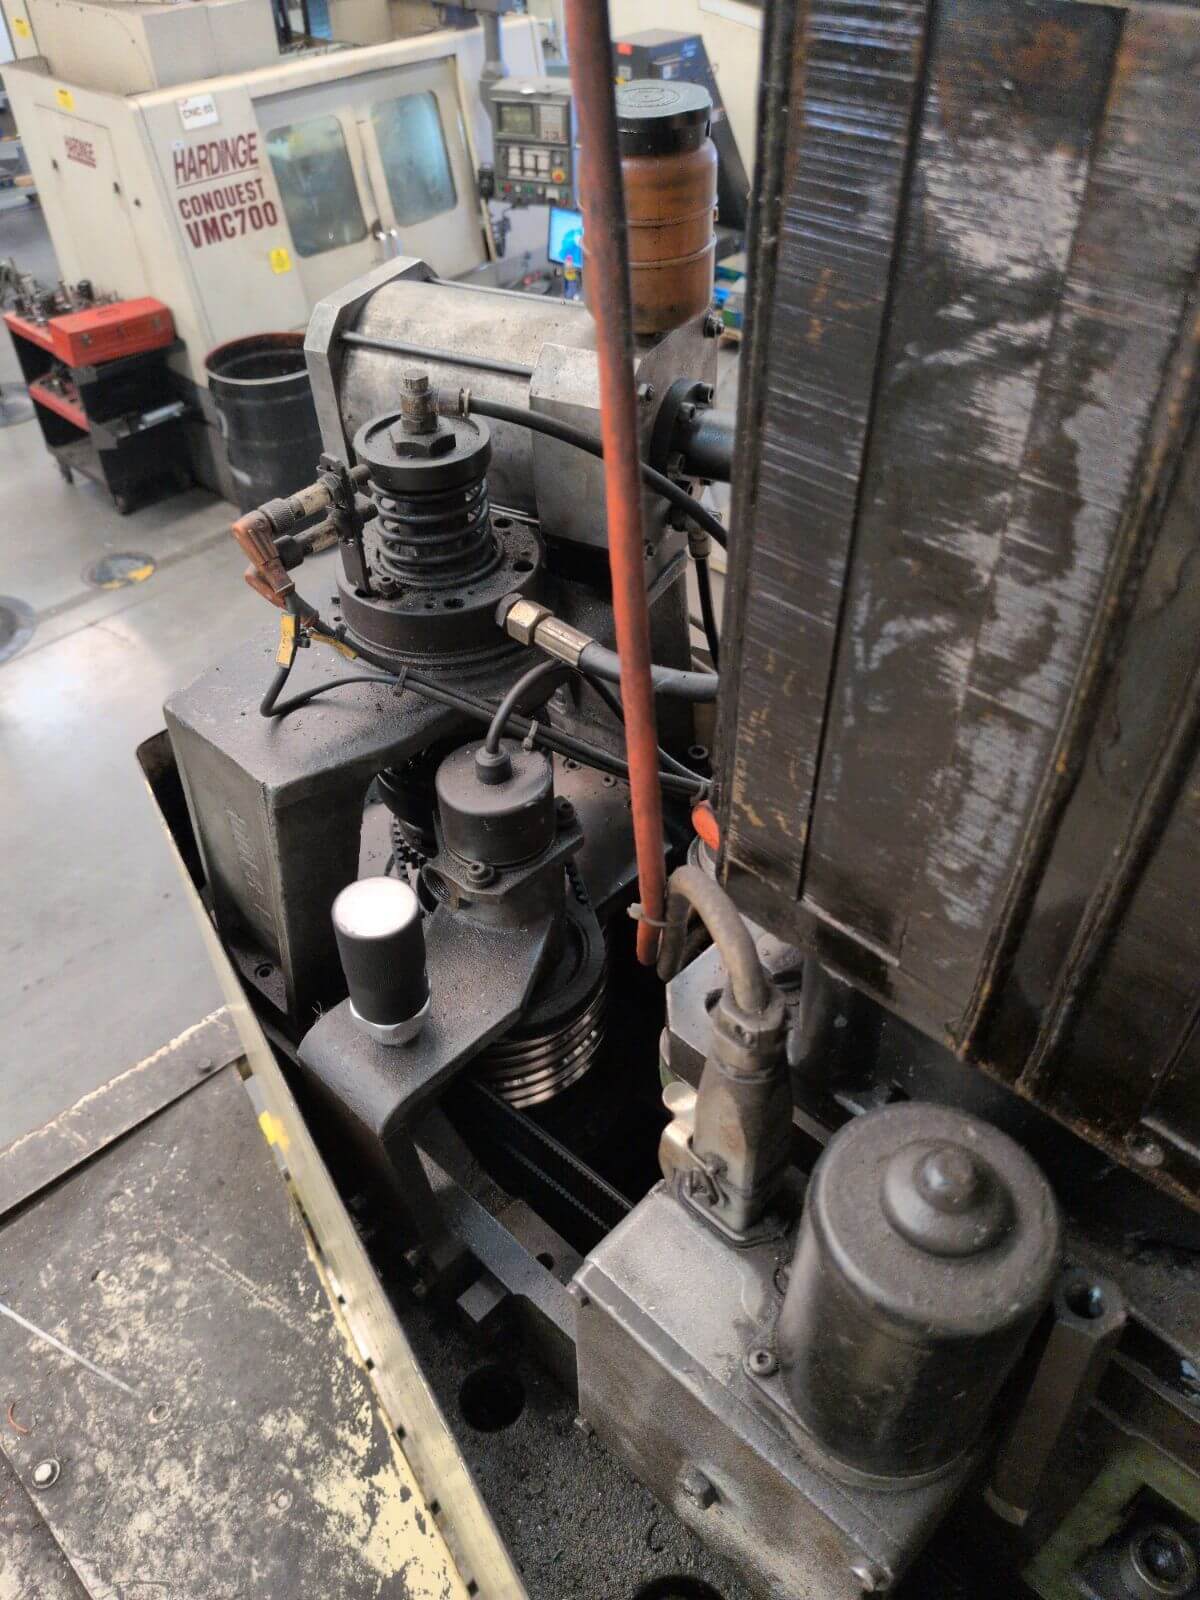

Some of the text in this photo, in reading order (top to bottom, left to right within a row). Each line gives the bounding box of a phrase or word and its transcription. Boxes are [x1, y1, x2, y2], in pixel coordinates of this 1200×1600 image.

[173, 132, 258, 185] HARDINGE
[178, 178, 264, 219] CONQUEST
[185, 201, 278, 248] VMC700
